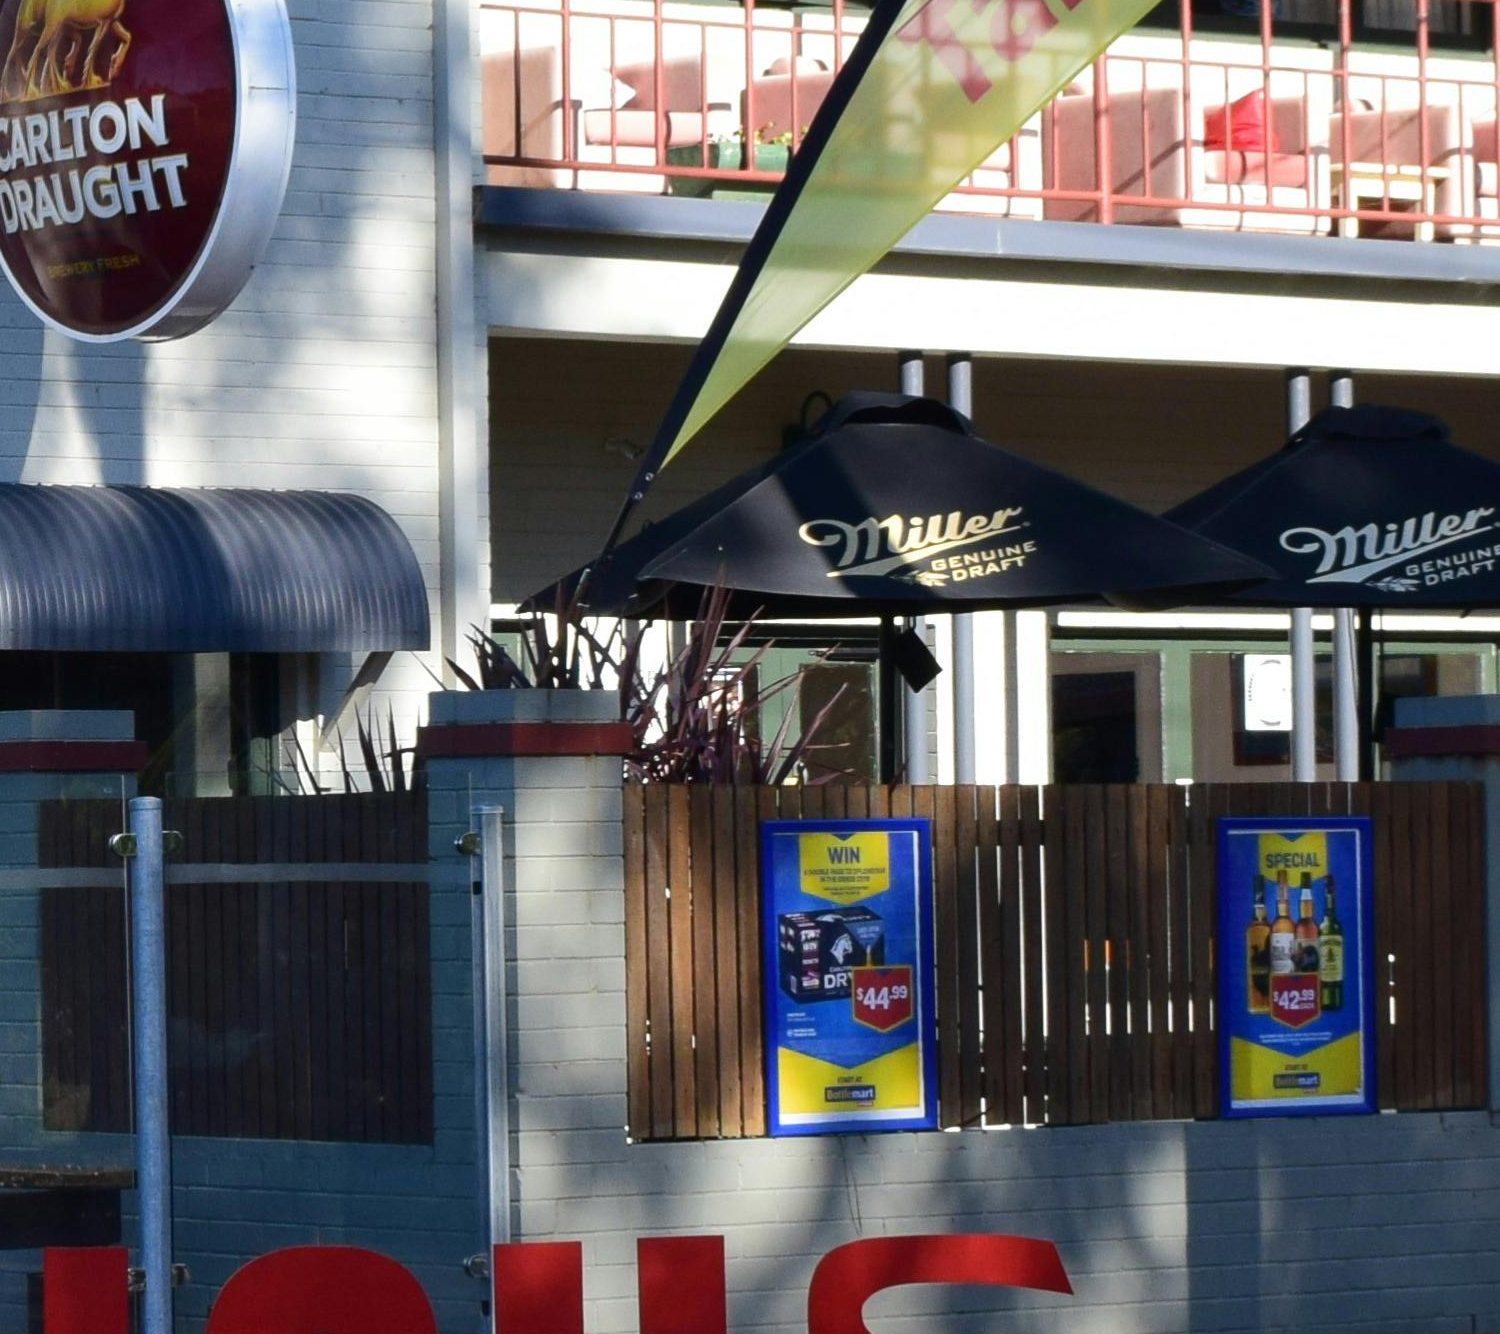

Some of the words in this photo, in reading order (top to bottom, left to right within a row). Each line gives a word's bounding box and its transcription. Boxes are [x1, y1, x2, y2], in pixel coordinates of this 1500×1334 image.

[799, 507, 1023, 567] Miller
[1279, 507, 1496, 574] Miller
[931, 540, 1037, 572] GENUINE
[952, 555, 1026, 582] DRAFT
[1424, 559, 1496, 586] DRAFT
[827, 846, 861, 864] WIN
[1265, 852, 1321, 869] SPECIAL
[856, 986, 908, 1010] $44.99
[1273, 989, 1316, 1010] $42.99
